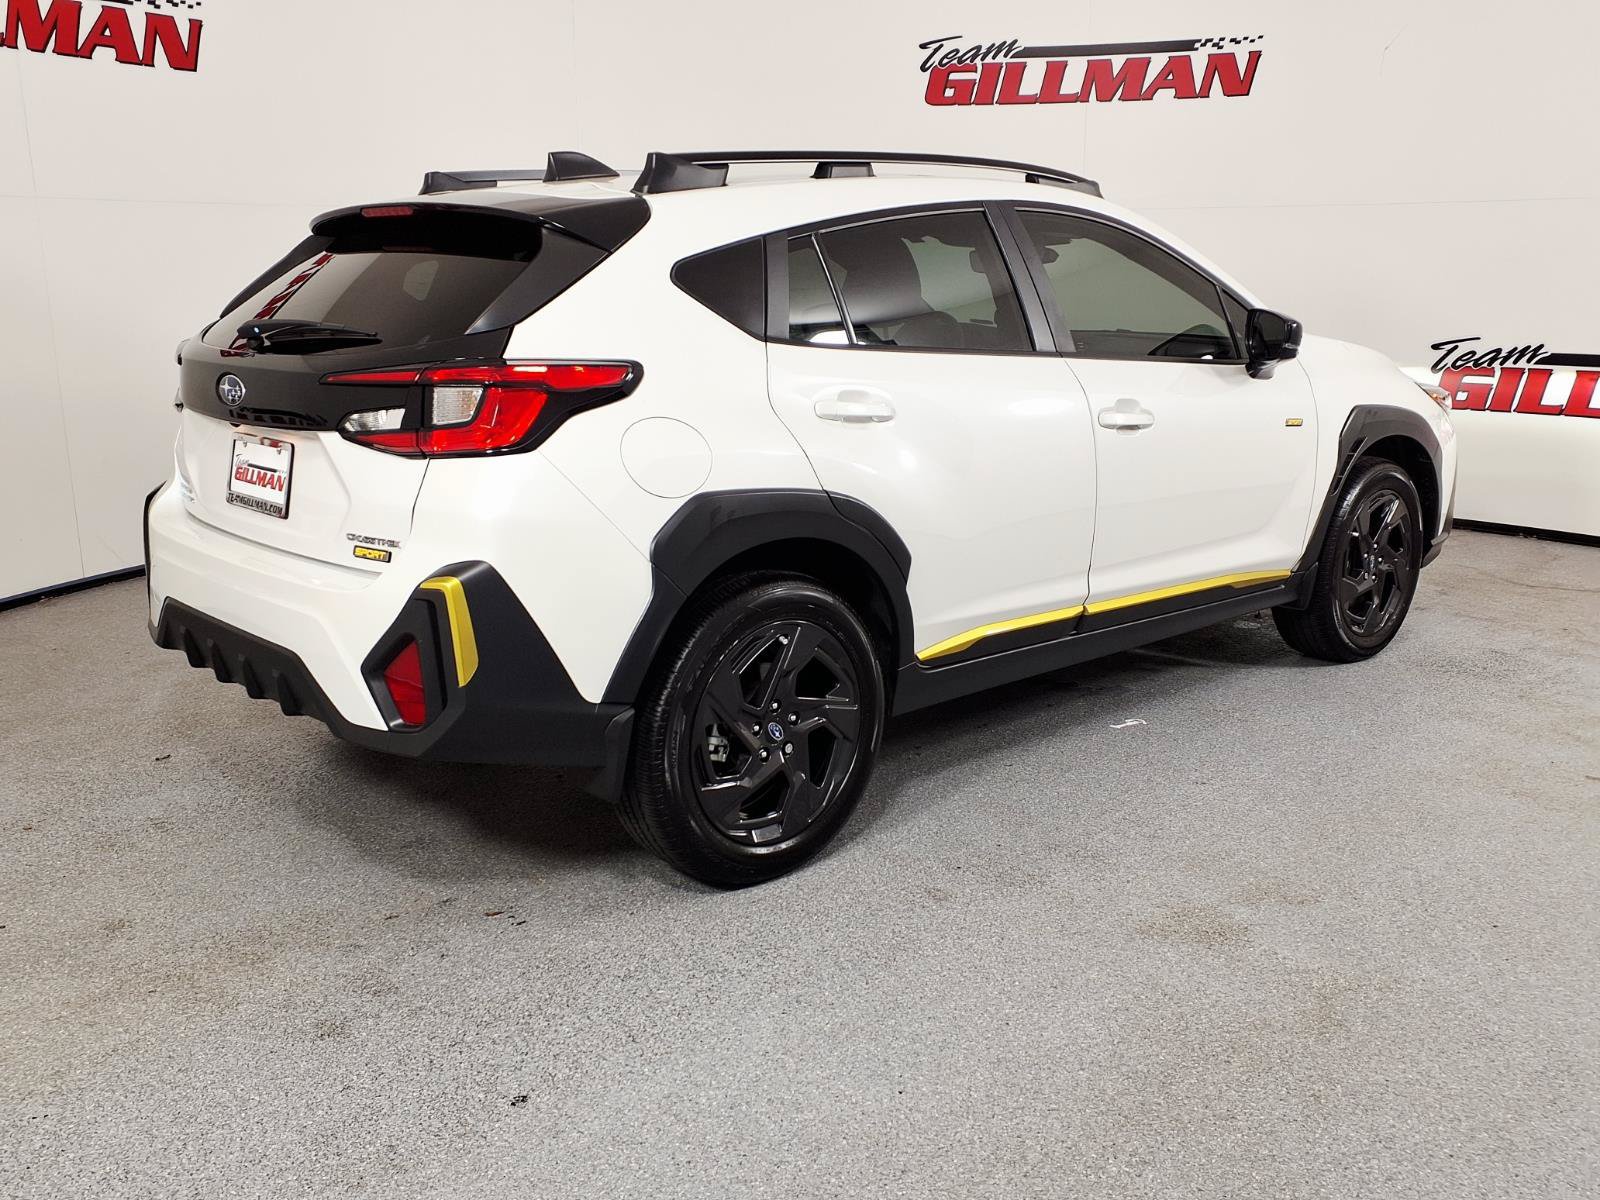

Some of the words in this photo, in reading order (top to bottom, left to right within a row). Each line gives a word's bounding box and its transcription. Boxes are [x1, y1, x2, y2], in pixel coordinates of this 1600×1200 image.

[0, 0, 203, 72] MAN
[918, 35, 1022, 72] Team
[924, 51, 1262, 106] GILLMAN
[1430, 337, 1548, 374] Team
[234, 465, 286, 492] GILLMAN
